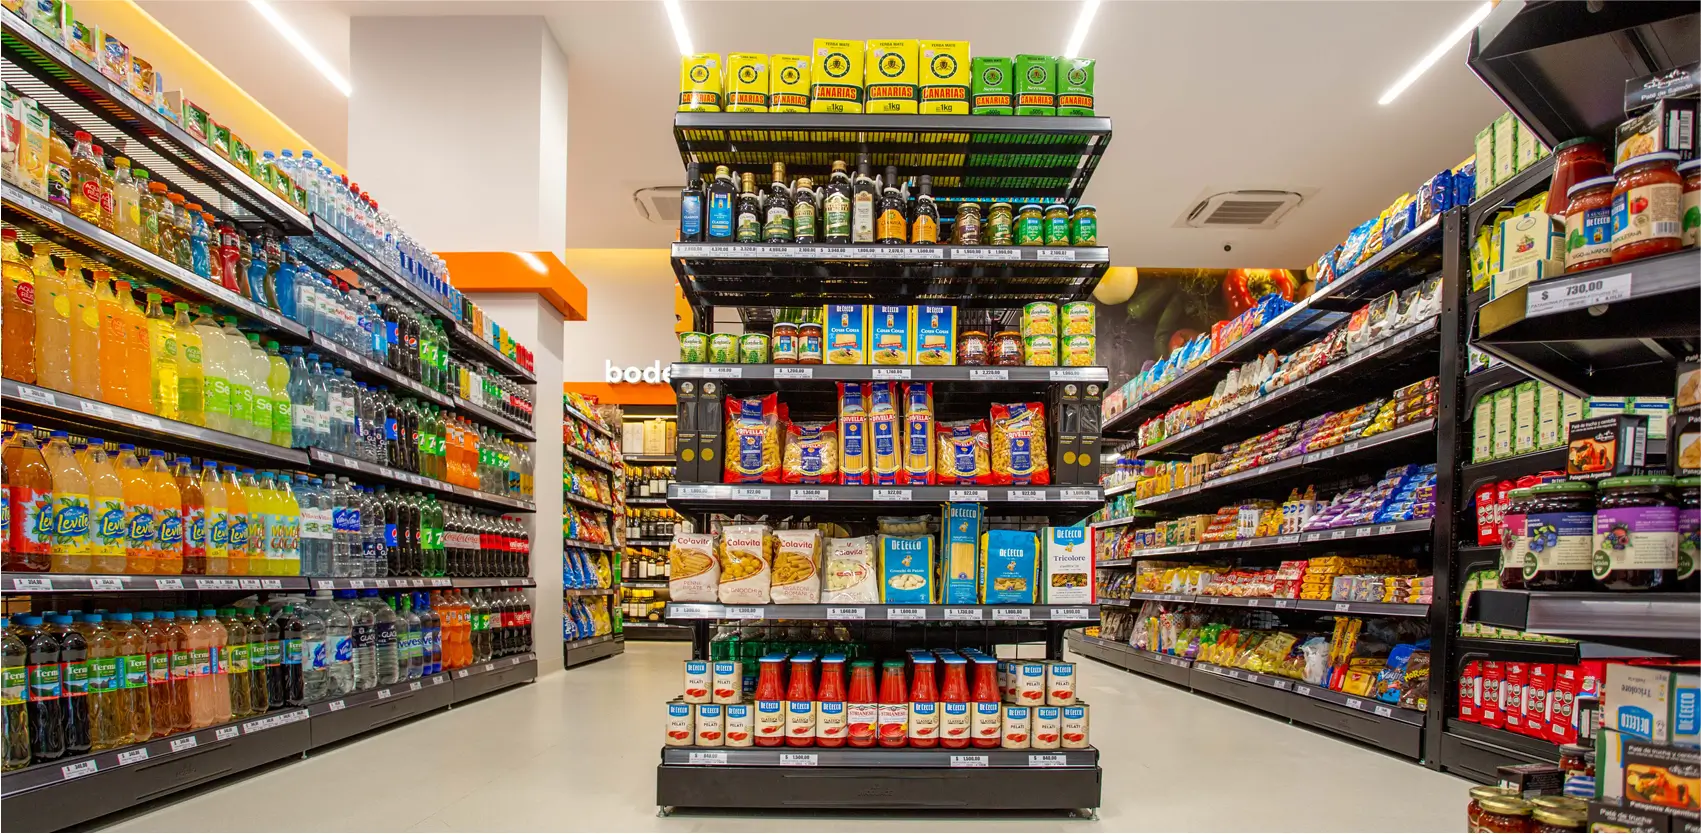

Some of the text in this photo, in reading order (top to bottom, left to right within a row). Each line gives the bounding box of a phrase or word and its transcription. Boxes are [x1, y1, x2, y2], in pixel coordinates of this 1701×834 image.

[814, 86, 857, 99] CANARIAS
[870, 84, 914, 99] CANARIAS
[922, 86, 965, 100] CANARIAS
[682, 93, 716, 103] CARIAS
[730, 94, 764, 104] CANARIAS
[773, 94, 807, 106] CANARIAS
[976, 96, 1010, 106] CANARIAS
[1020, 95, 1053, 106] CANARIAS
[1060, 96, 1092, 108] CANARIAS
[832, 104, 844, 112] 1kg
[888, 102, 900, 112] 1kg
[940, 104, 953, 113] 1kg
[1586, 216, 1610, 227] DE CECCO
[1541, 290, 1549, 300] $
[1566, 280, 1603, 296] 730.00
[951, 507, 977, 518] DE CECCO
[1057, 529, 1082, 538] DE CECCO
[782, 540, 813, 549] Colavita
[891, 540, 922, 550] DE CECCO
[1000, 548, 1024, 558] DE CECCO
[1053, 554, 1086, 562] Tricolore
[721, 664, 732, 672] CECCO
[1621, 684, 1652, 698] Tricolore
[1678, 692, 1696, 730] DE CECCO
[1620, 714, 1650, 735] DE CECCO
[1652, 748, 1671, 756] trucha
[1630, 801, 1700, 818] Patagonia Argentina
[1600, 808, 1616, 817] Paté
[1628, 813, 1652, 824] trucha
